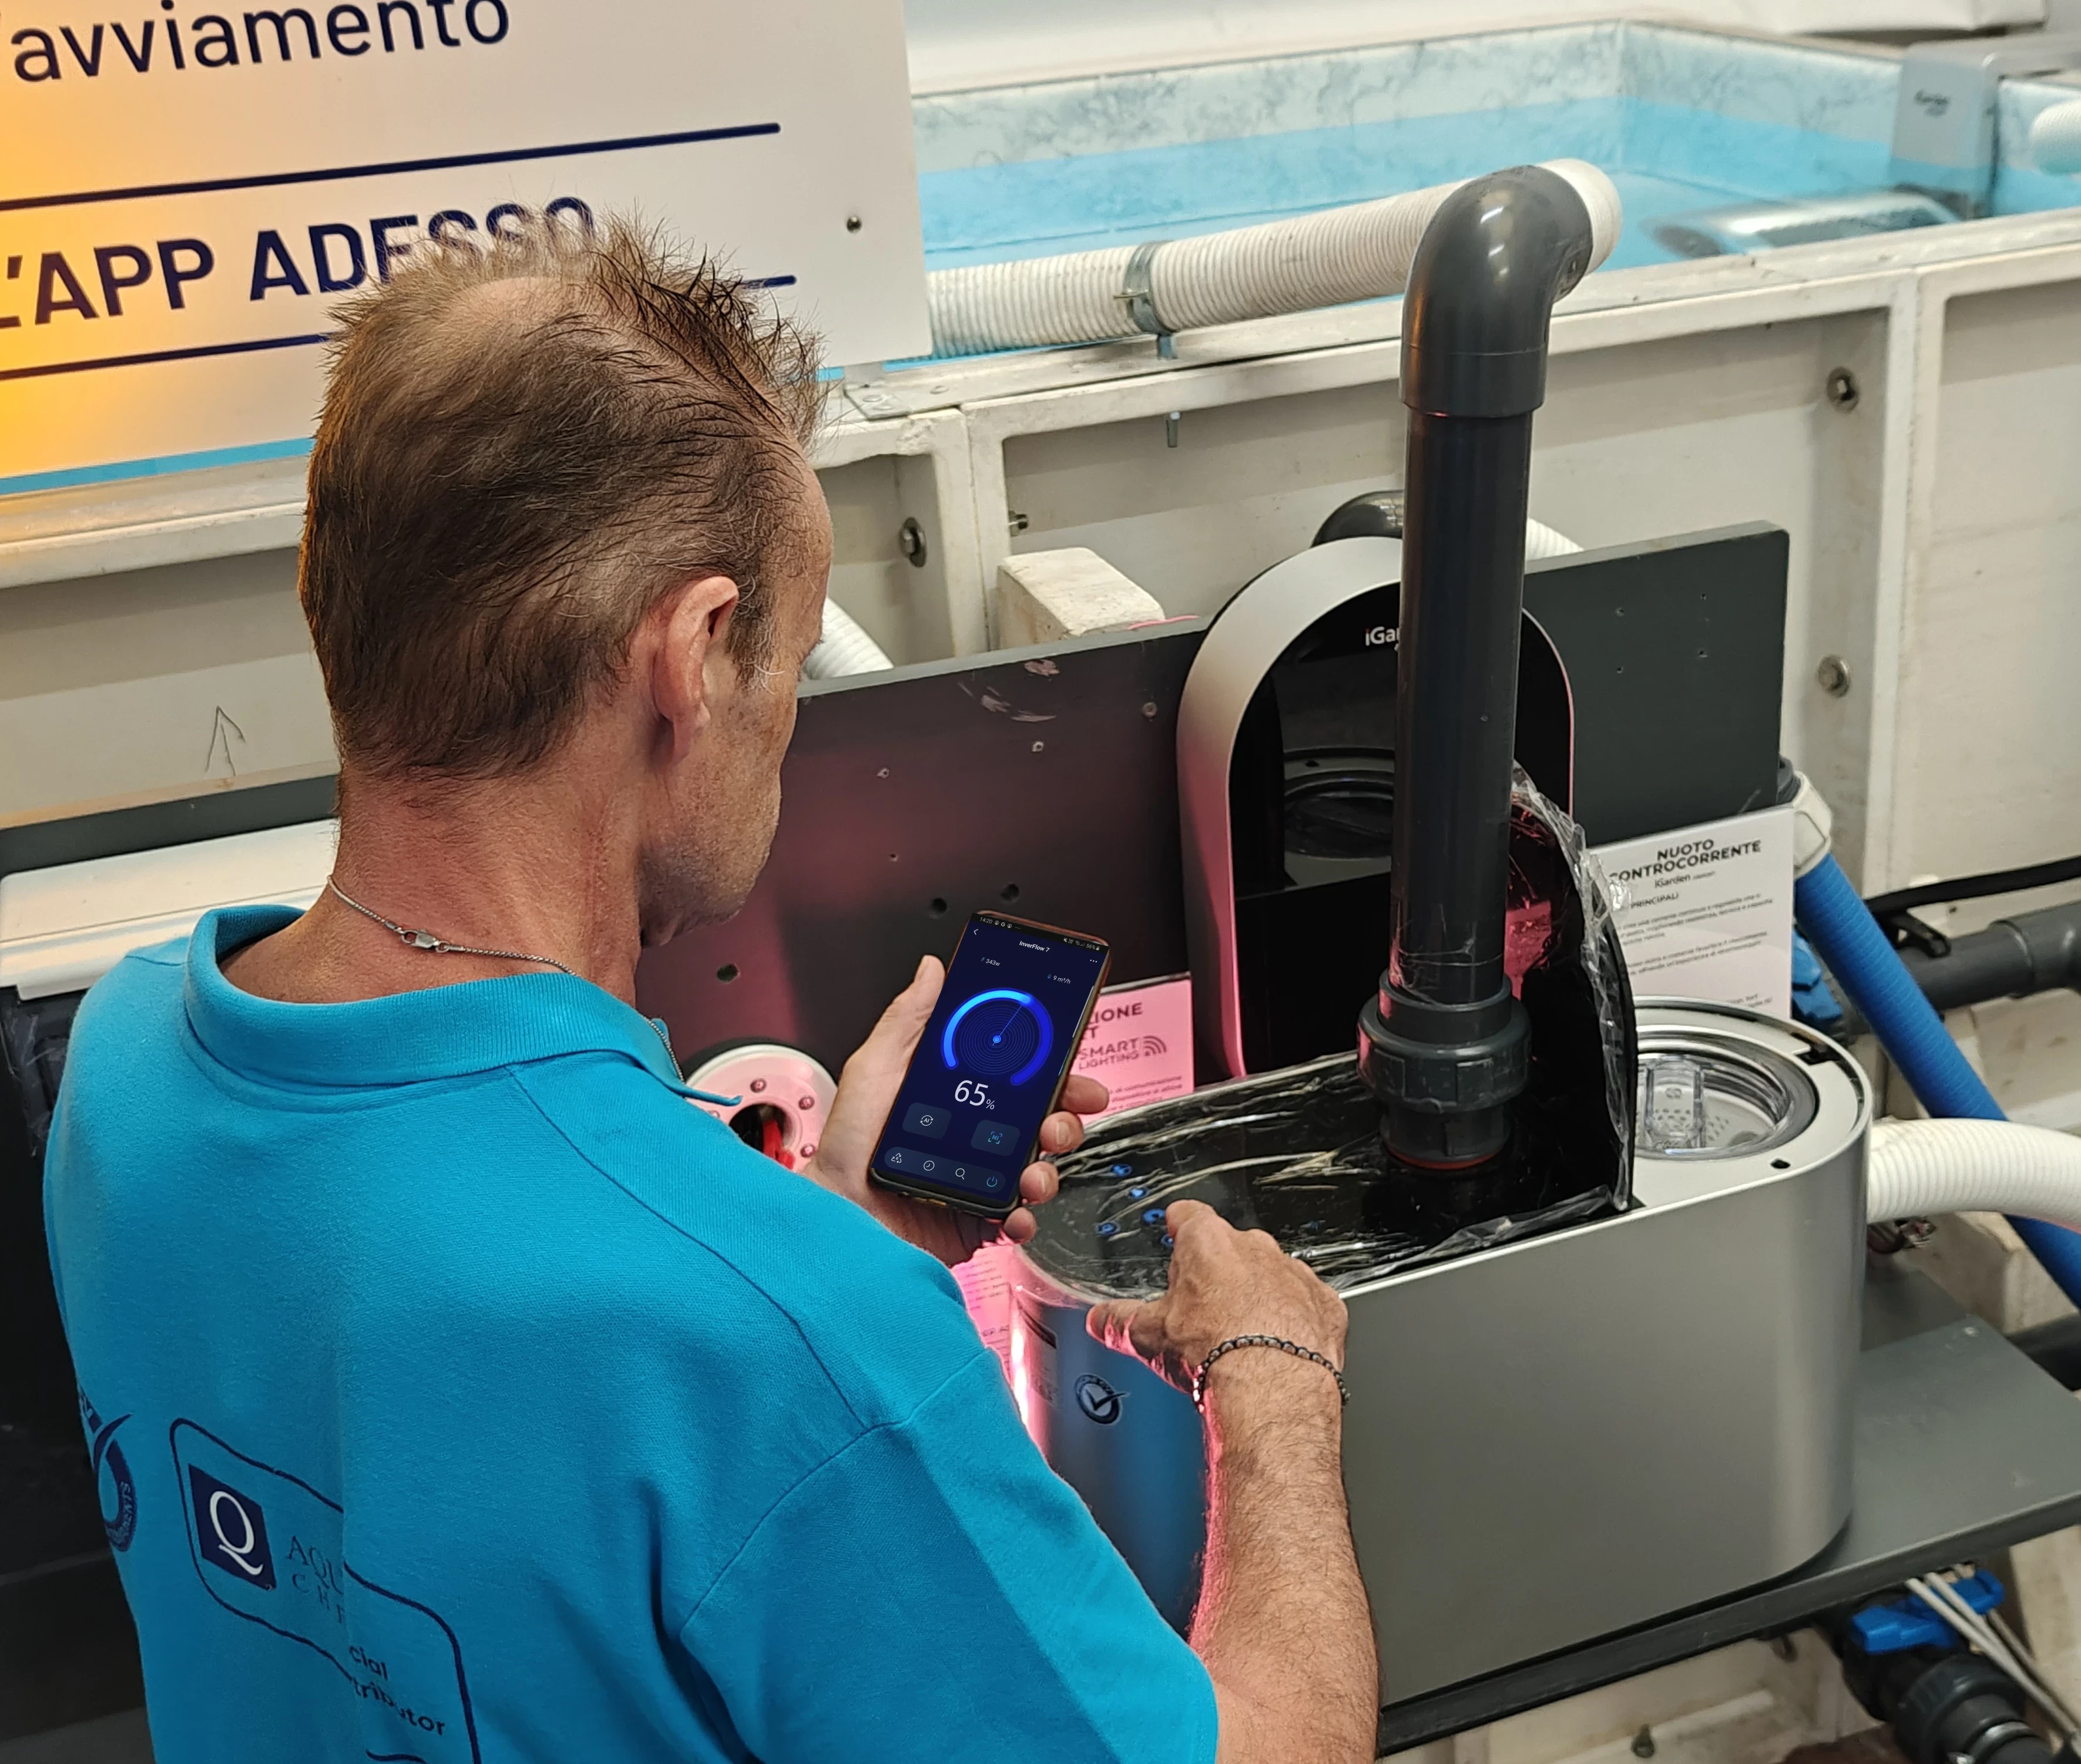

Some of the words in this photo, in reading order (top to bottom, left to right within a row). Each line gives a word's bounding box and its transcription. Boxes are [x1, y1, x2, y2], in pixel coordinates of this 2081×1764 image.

[1657, 839, 1714, 861] NUOTO
[1019, 940, 1045, 951] InverFlow
[1079, 1037, 1139, 1060] SMART
[209, 1490, 263, 1575] Q
